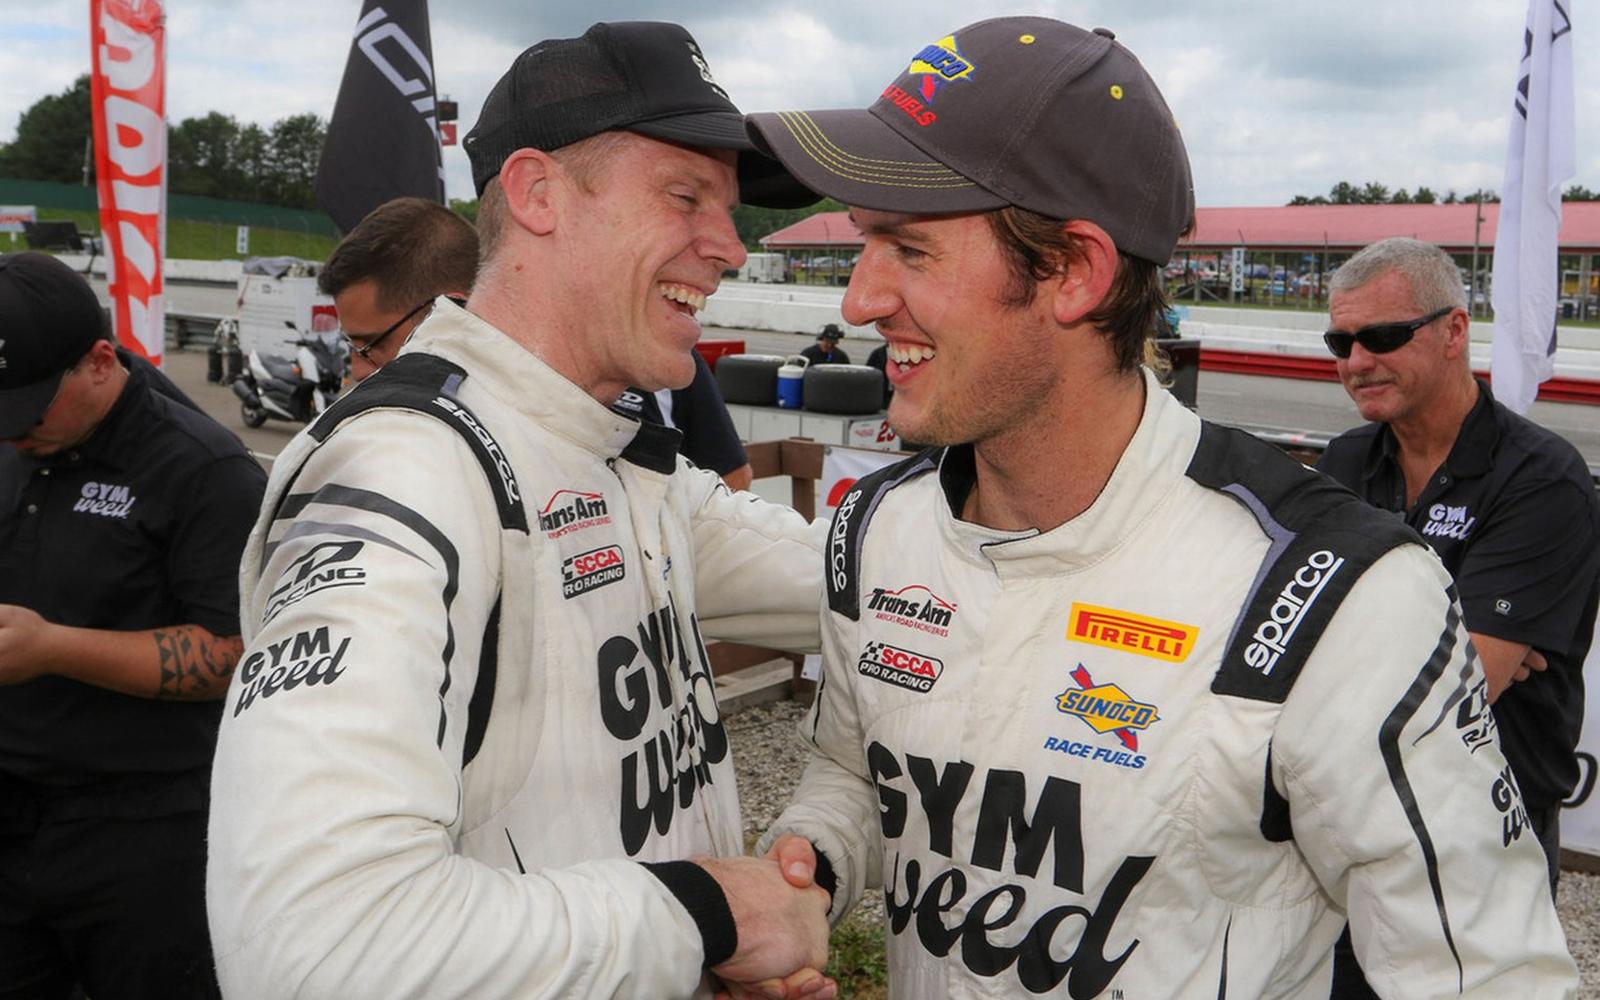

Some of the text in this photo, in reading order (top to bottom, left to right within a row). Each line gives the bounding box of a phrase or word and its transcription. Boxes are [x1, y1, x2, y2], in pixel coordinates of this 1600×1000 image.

[433, 396, 521, 506] sparco
[73, 496, 136, 519] weed
[80, 481, 130, 503] GYM
[575, 497, 608, 521] Am
[1429, 503, 1467, 524] GYM
[833, 490, 862, 592] sparco
[574, 549, 621, 577] SCCA
[584, 566, 624, 590] RACING
[867, 588, 953, 627] Trans Am
[1244, 550, 1335, 670] sparco
[1074, 610, 1187, 657] PIRELLI
[240, 627, 331, 684] GYM
[881, 648, 935, 677] SCCA
[234, 638, 351, 718] weed
[860, 661, 931, 689] PRO RACING
[1063, 692, 1152, 726] SUNOCO
[1044, 737, 1147, 769] RACE FUELS
[867, 741, 1084, 895] GYM
[884, 852, 1157, 1000] weed
